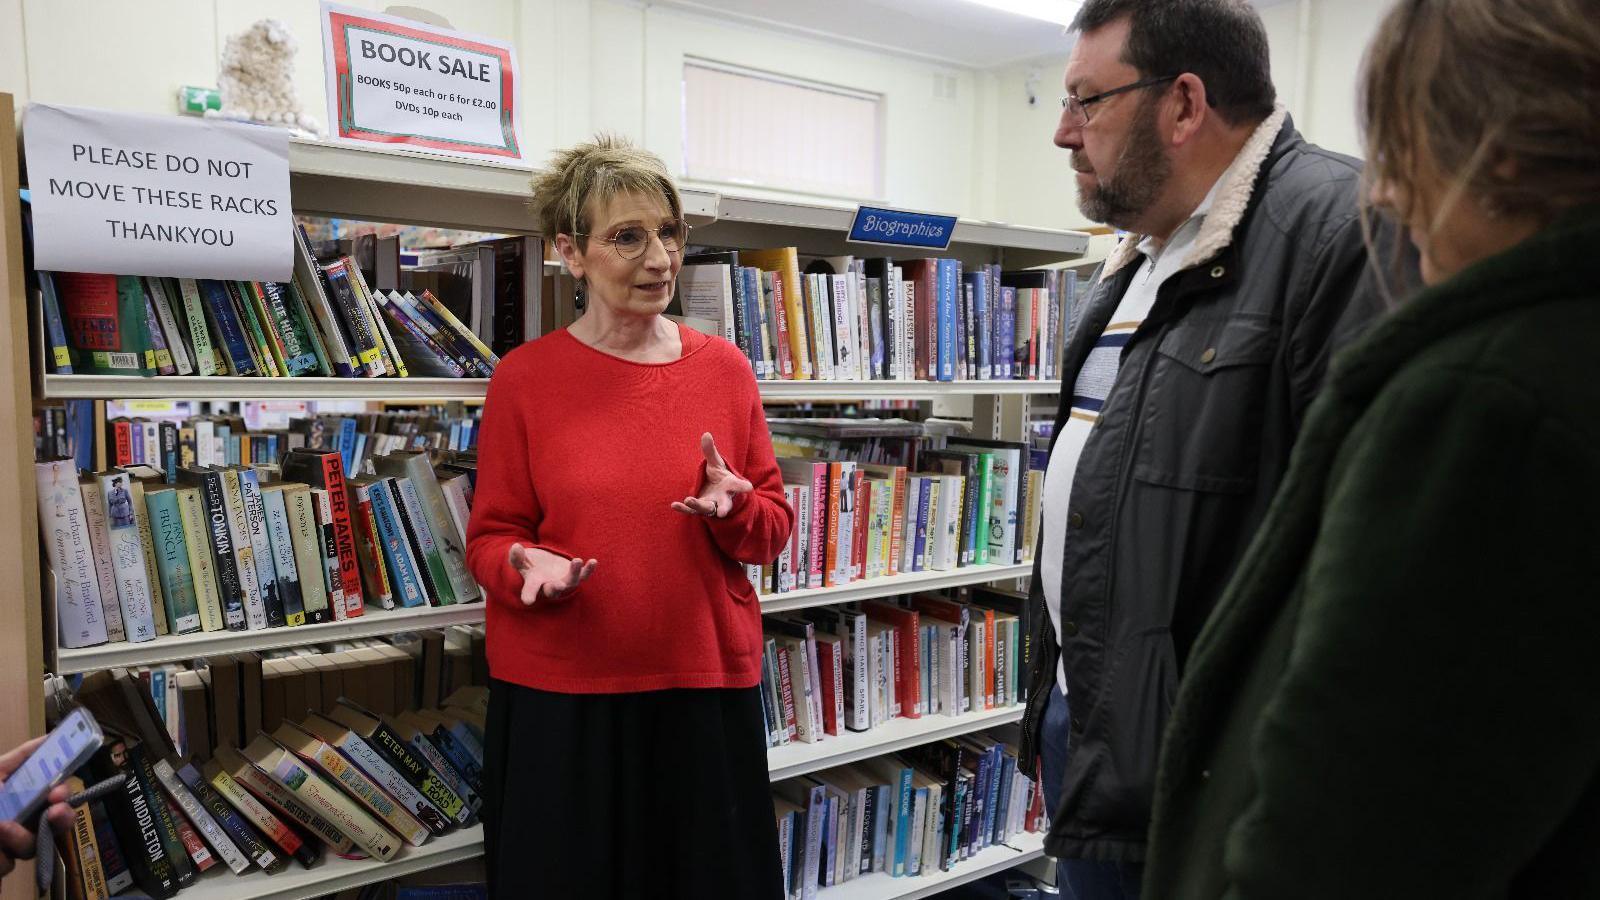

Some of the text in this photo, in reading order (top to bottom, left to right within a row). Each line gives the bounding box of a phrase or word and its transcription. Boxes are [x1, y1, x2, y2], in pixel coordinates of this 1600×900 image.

[360, 39, 491, 83] BOOK SALE
[357, 74, 496, 110] BOOKS 50p each or 6 for £2.00
[395, 100, 463, 122] DVDs 10p each
[72, 144, 254, 179] PLEASE DO NOT
[49, 178, 278, 216] MOVE THESE RACKS
[105, 219, 235, 247] THANKYOU
[862, 215, 944, 238] Biographies
[905, 282, 913, 308] BRIAN
[280, 319, 301, 358] HIGSON
[297, 356, 309, 366] YA
[118, 425, 128, 455] PETER
[227, 474, 241, 505] ANNA
[252, 491, 265, 523] JAMES
[812, 477, 820, 520] WINDSWEPT
[206, 476, 232, 555] PETER TONKIN
[242, 481, 260, 536] PATTERSON
[326, 458, 355, 573] PETER JAMES
[815, 474, 827, 571] BILLY CONNOLLY
[828, 478, 840, 545] Billy Connolly
[158, 508, 178, 561] FRENCH
[809, 527, 817, 572] INTERESTING
[70, 547, 91, 581] Taylor
[394, 551, 409, 578] ADAM
[78, 580, 99, 624] Bradford
[778, 651, 793, 720] WARREN GATLAND
[377, 729, 423, 775] PETER MAY
[427, 774, 459, 805] COFFIN
[992, 767, 1000, 790] KEVIN
[211, 801, 233, 823] GIRL
[425, 785, 451, 811] ROAD
[77, 809, 90, 846] RANKIN
[131, 795, 164, 863] MIDDLETON
[159, 808, 177, 842] HARROW
[284, 799, 312, 826] SISTERS
[311, 815, 343, 845] BROTHERS
